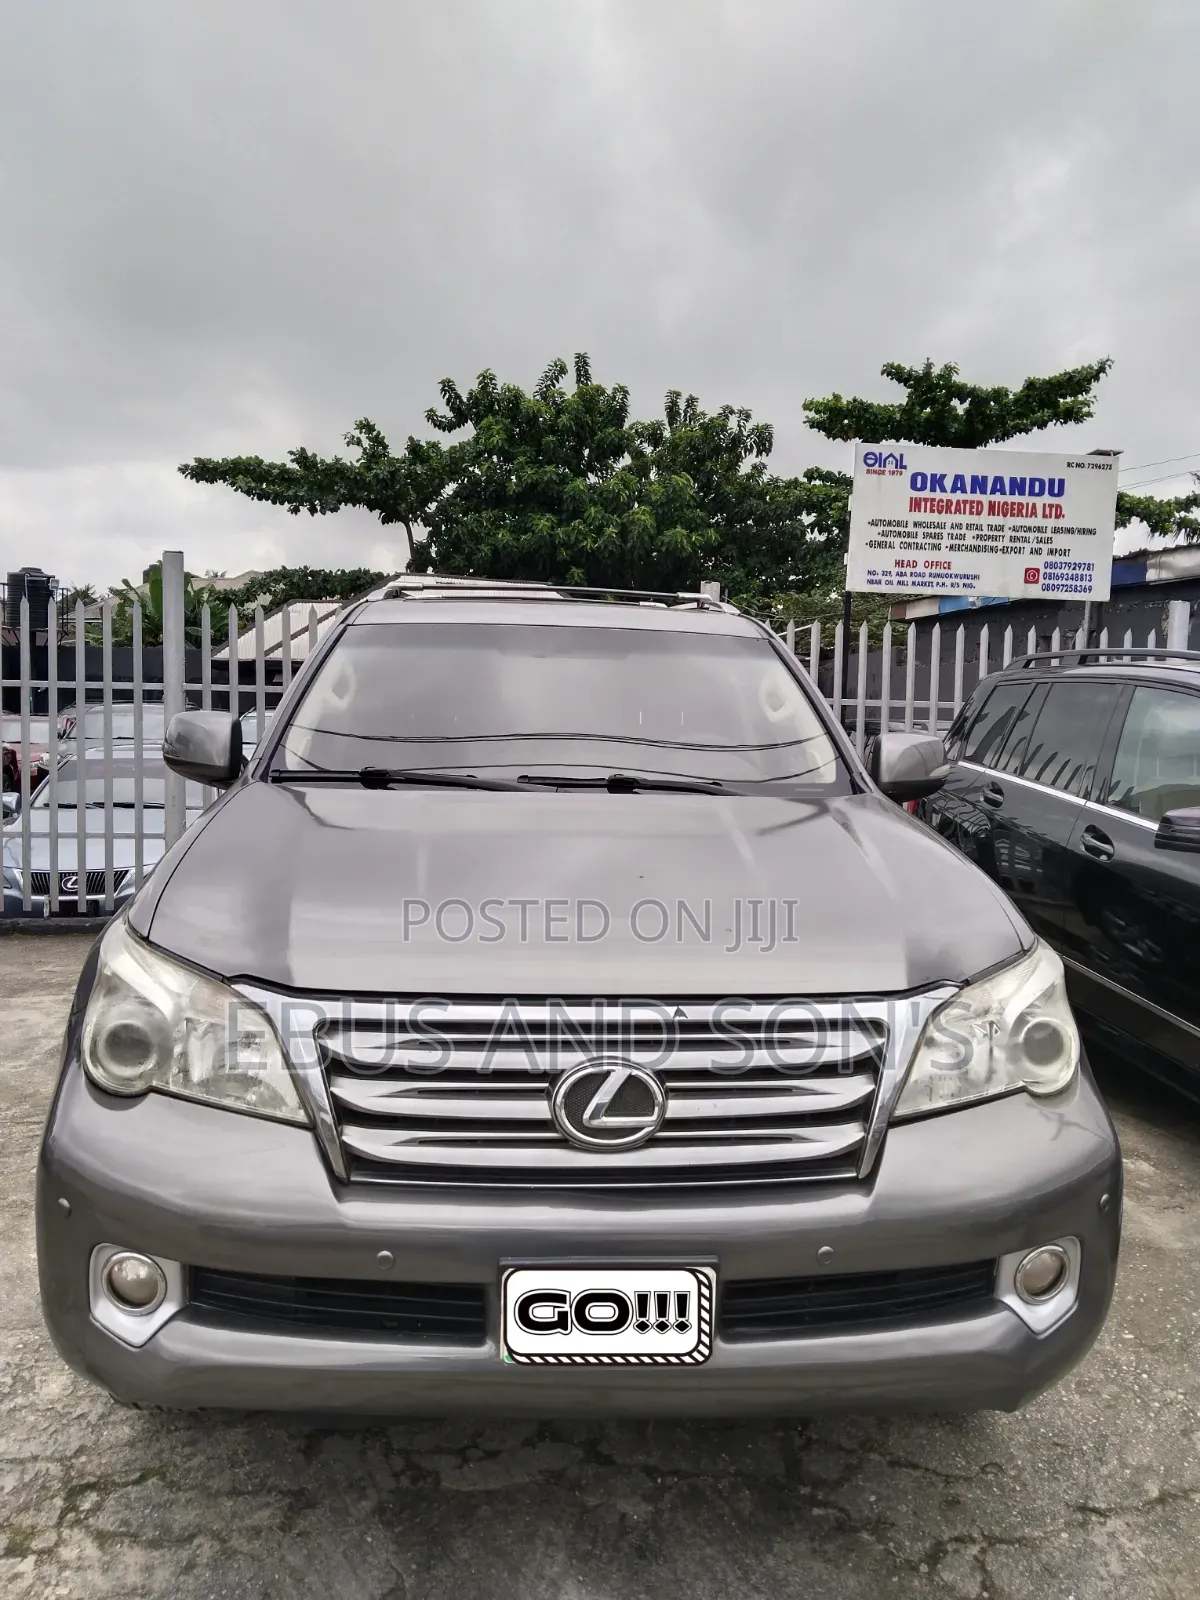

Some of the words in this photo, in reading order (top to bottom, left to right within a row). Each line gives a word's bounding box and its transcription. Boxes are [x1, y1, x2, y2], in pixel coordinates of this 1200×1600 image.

[910, 472, 1065, 497] OKANANDU
[909, 497, 984, 516] INTEGRATED
[988, 500, 1038, 518] NIGERIA
[1042, 503, 1065, 519] LTD.
[870, 519, 908, 528] AUTOMOBILE
[913, 521, 946, 530] WHOLESALE
[950, 522, 963, 530] AND
[966, 523, 983, 532] RETAIL
[987, 524, 1005, 532] TRADE
[1012, 525, 1048, 534] AUTOMOBILE
[1051, 526, 1097, 536] LEASING/HIRING
[881, 530, 918, 539] AUTOMOBILE
[922, 532, 944, 540] SPARES
[976, 534, 1005, 543] PROPERTY
[869, 540, 895, 549] GENERAL
[900, 541, 942, 552] CONTRACTING
[949, 544, 999, 554] MERCHANDISING
[1002, 546, 1025, 554] EXPORT
[1030, 547, 1042, 556] AND
[1047, 548, 1071, 557] IMPORT
[894, 560, 917, 568] HEAD
[924, 560, 952, 569] OFFICE
[1044, 561, 1094, 571] 08037929781
[1043, 572, 1092, 582] 08169348813
[1041, 583, 1092, 593] 08097258369
